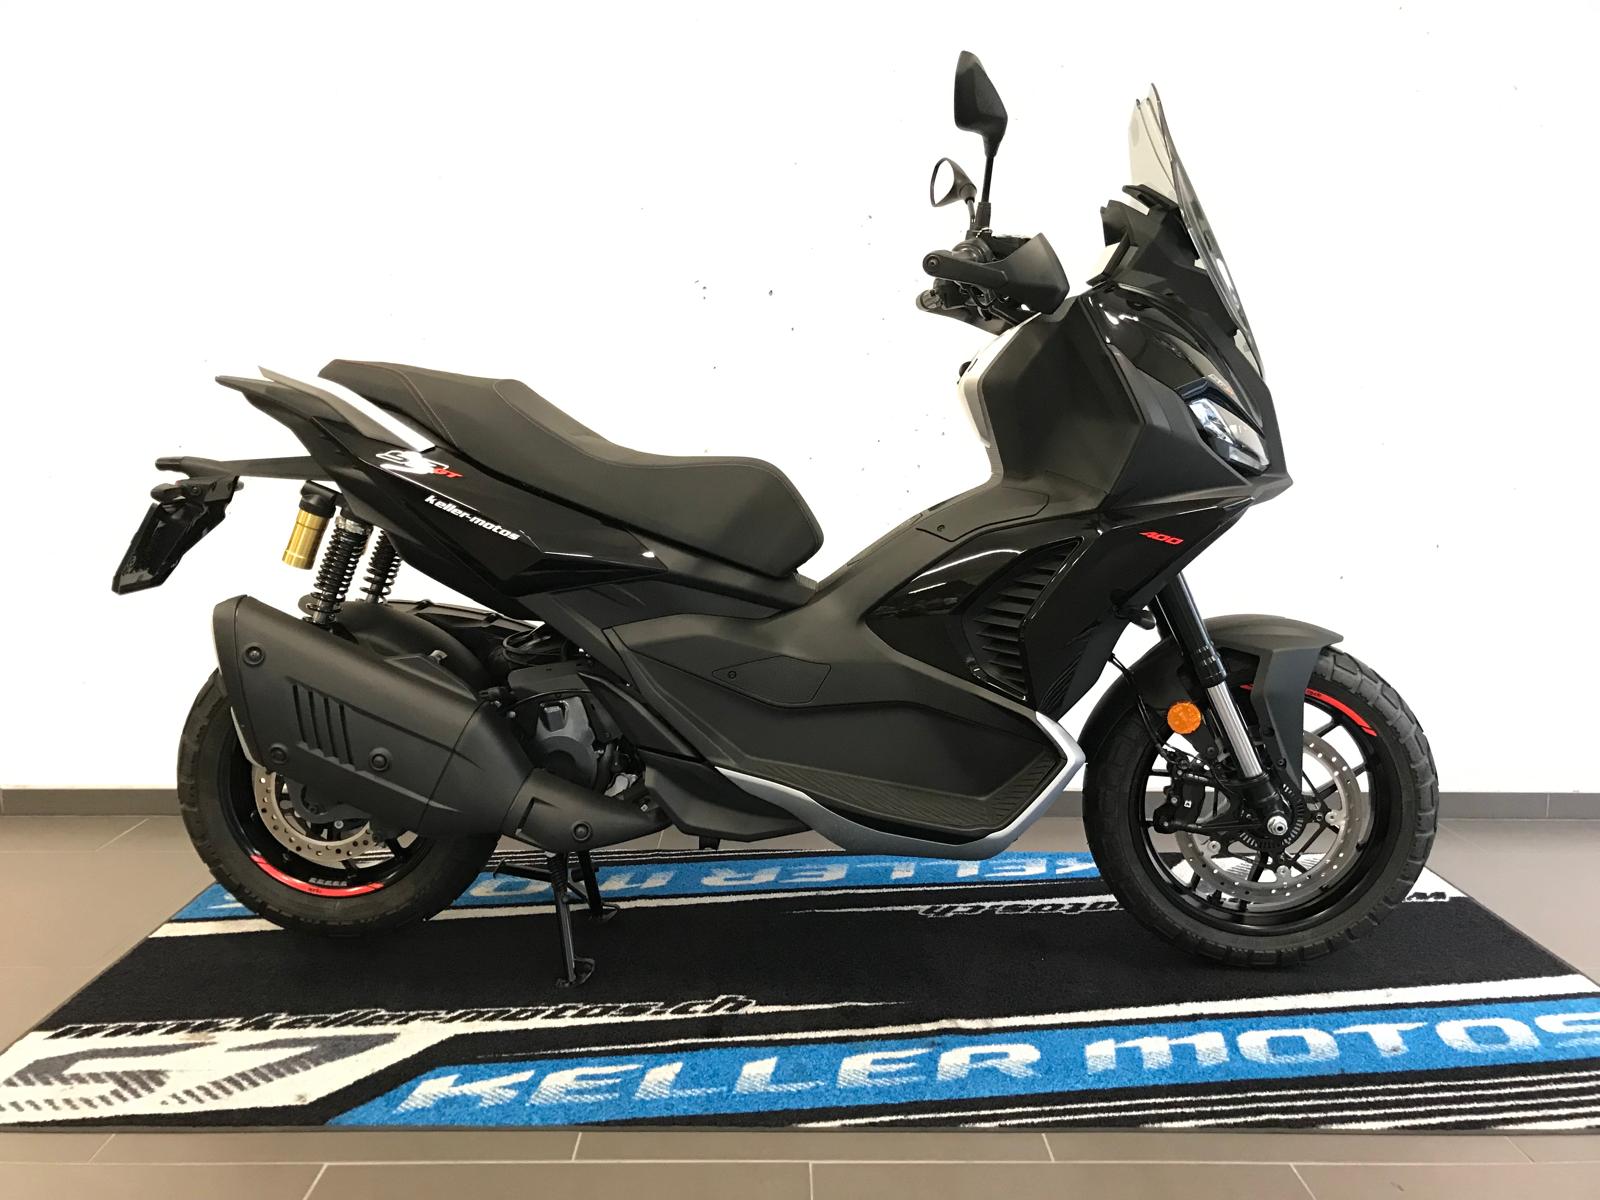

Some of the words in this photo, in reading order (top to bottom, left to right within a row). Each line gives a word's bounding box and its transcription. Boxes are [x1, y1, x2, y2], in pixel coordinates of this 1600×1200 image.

[424, 495, 521, 541] keller-motos
[1139, 531, 1184, 545] 400
[393, 1042, 1042, 1114] KELLER
[1085, 1011, 1600, 1075] MOTOS
